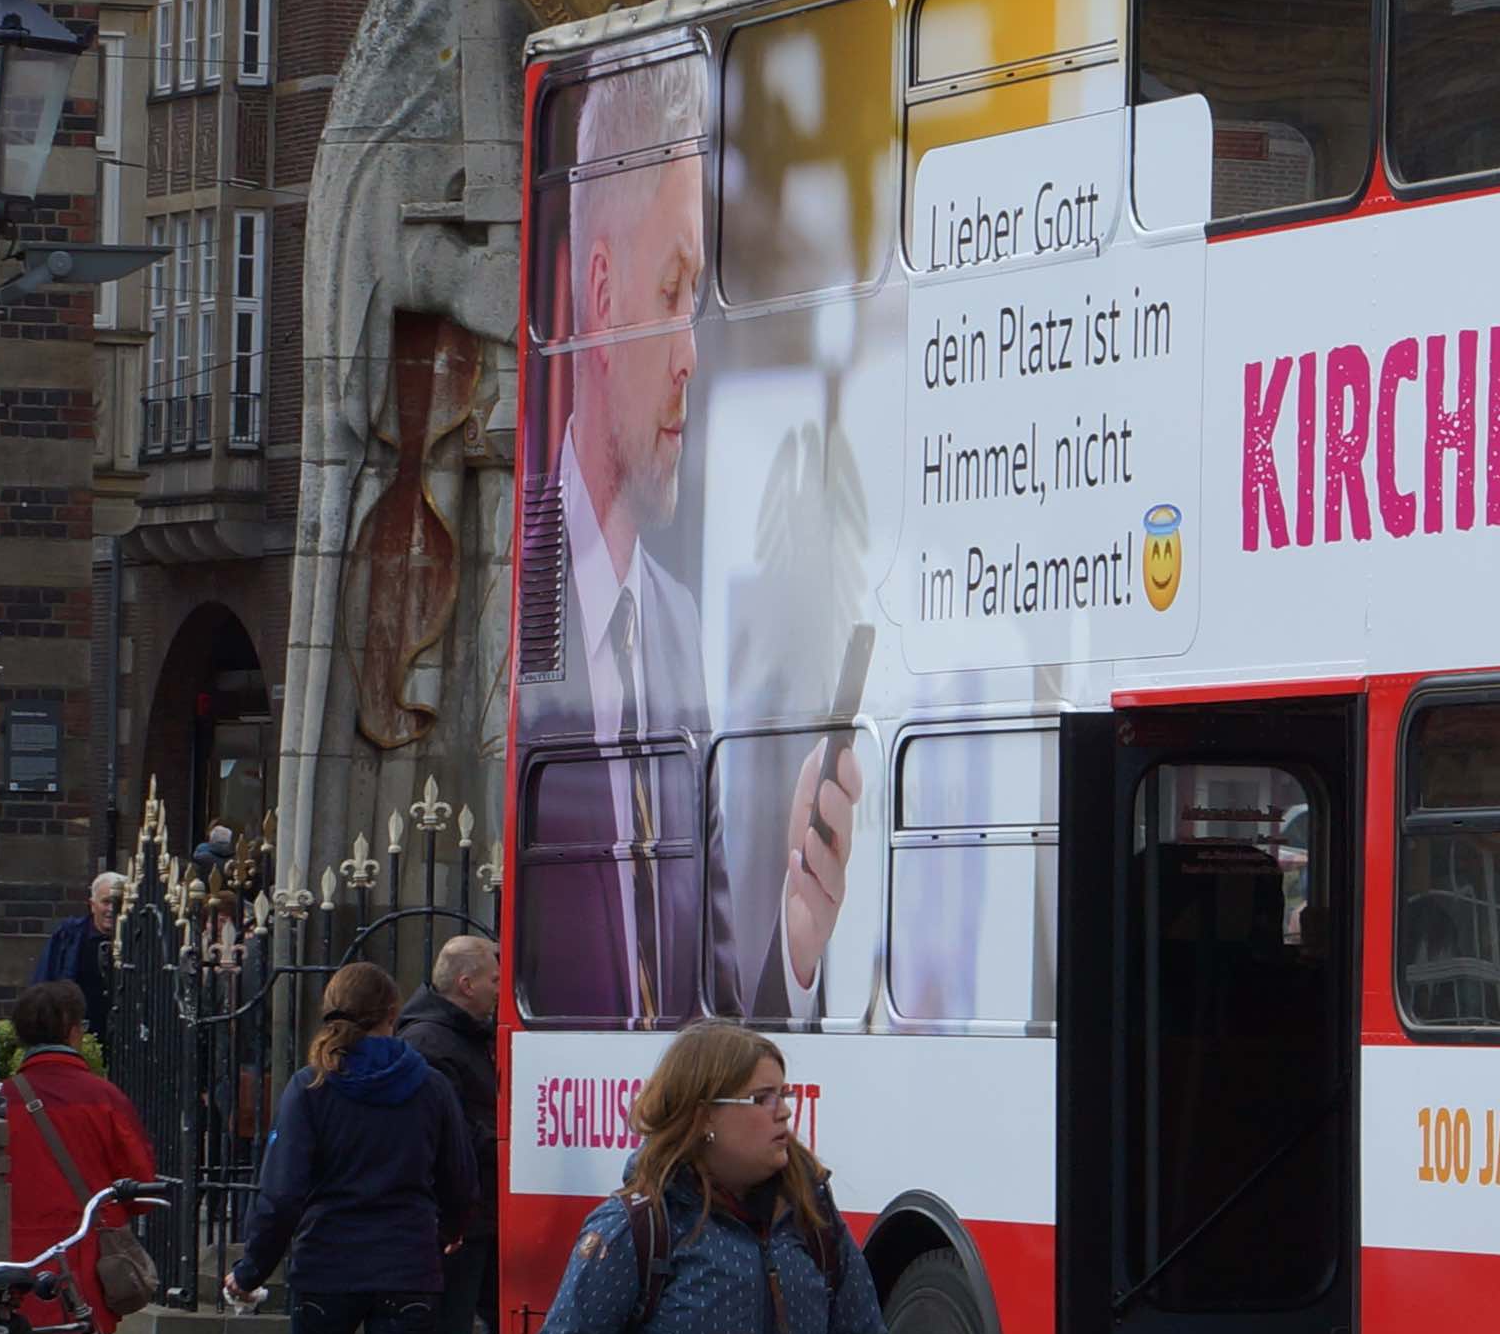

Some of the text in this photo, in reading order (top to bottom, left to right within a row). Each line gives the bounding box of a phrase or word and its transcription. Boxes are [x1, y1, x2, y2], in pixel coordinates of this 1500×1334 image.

[927, 196, 1024, 273] Lieber
[924, 286, 1170, 390] dein Platz ist im
[922, 412, 1133, 506] Himmel, nicht
[920, 530, 1132, 621] im Parlament!
[1417, 1105, 1473, 1183] 100
